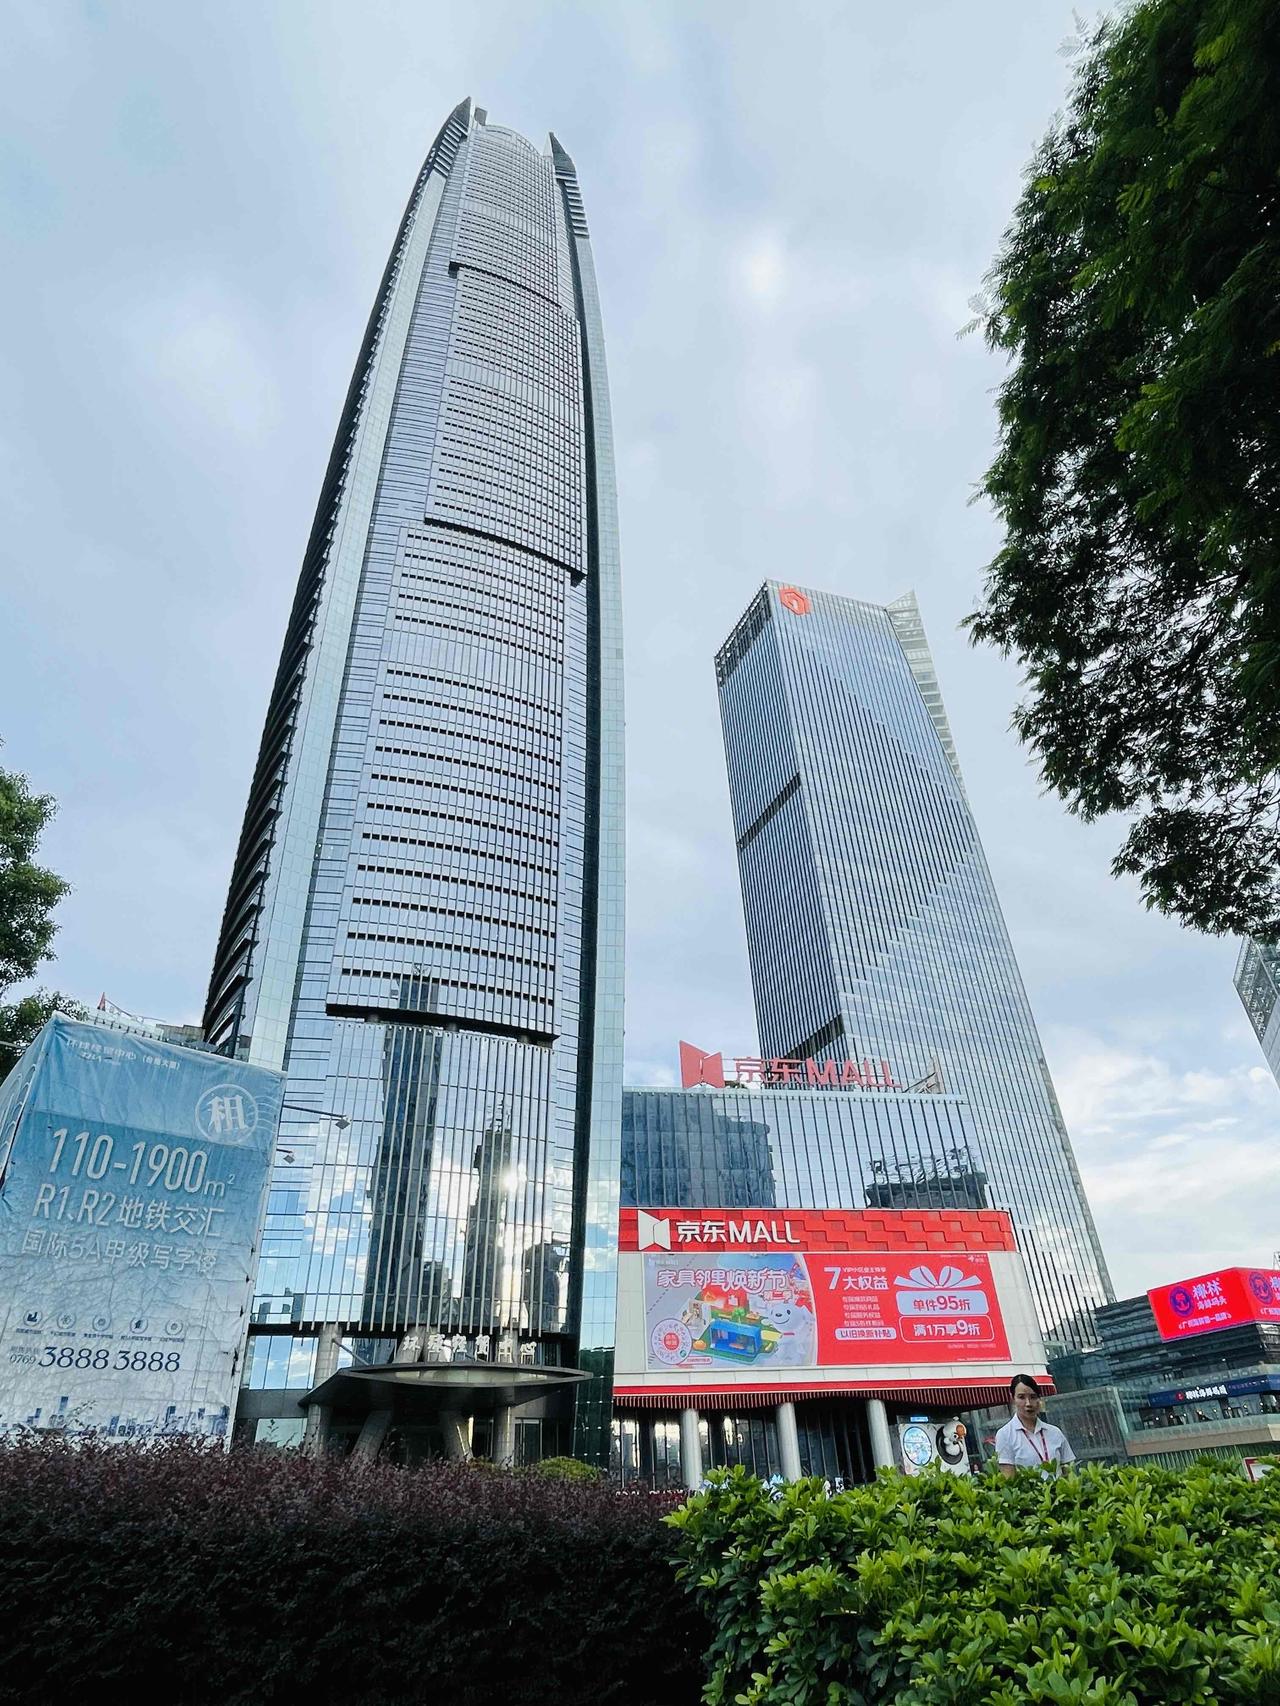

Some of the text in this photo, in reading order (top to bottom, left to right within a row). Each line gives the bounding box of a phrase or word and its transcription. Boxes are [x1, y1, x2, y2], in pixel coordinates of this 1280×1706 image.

[733, 1056, 903, 1089] 京东MALL
[207, 1093, 249, 1134] 租
[676, 1220, 801, 1243] 京东MALL
[22, 1229, 218, 1274] 国际5A甲级写字楼
[913, 1295, 971, 1312] 单件95折
[913, 1319, 981, 1337] 满1万享9折
[10, 1354, 36, 1365] 0769
